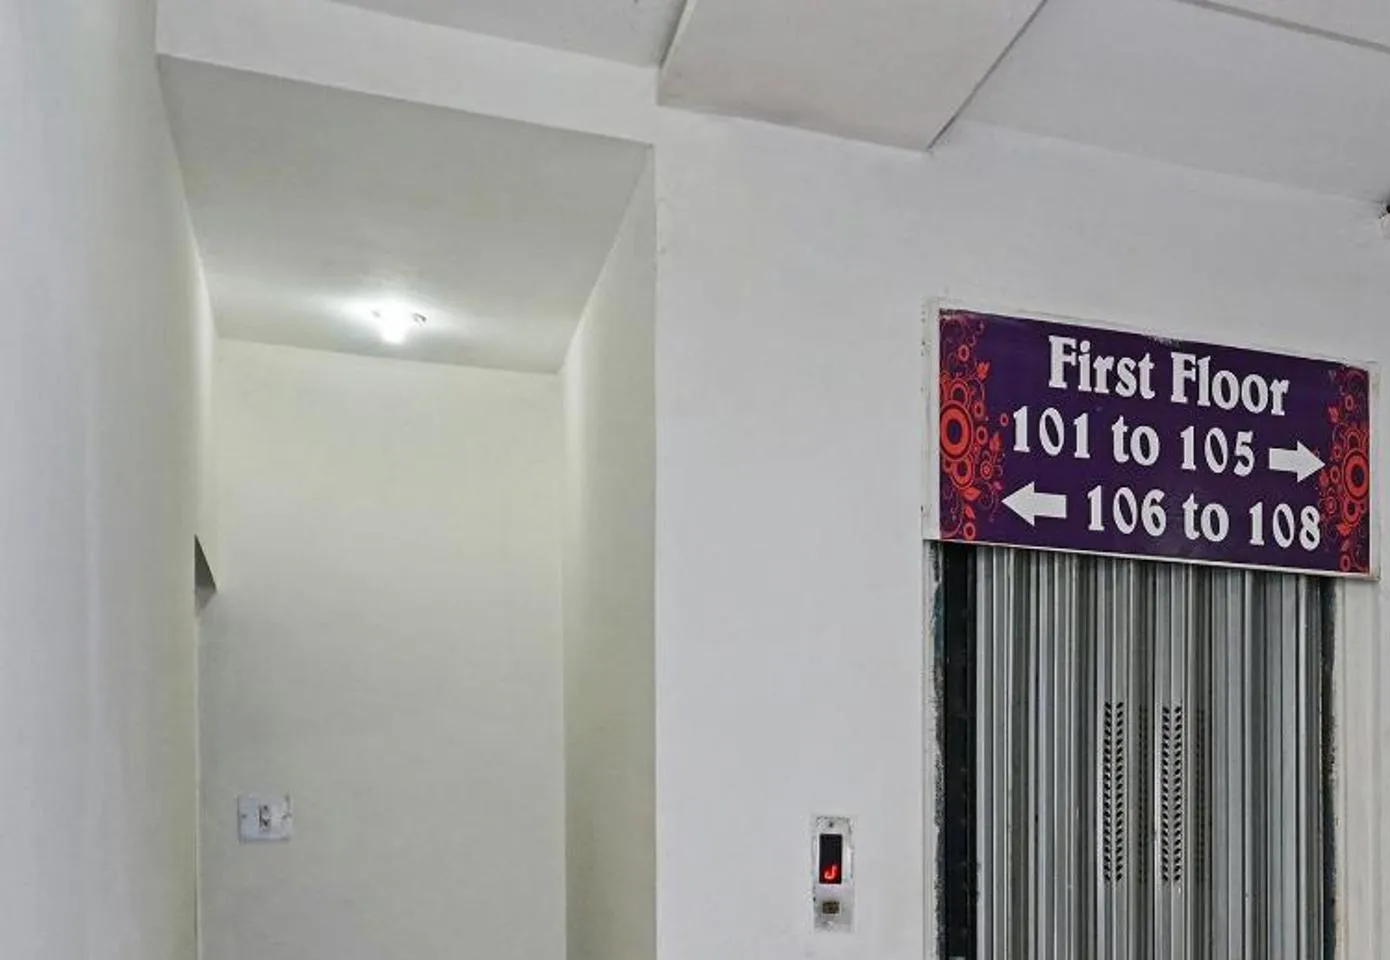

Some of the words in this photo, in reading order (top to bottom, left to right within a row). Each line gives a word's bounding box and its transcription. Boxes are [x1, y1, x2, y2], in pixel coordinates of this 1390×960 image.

[1048, 335, 1156, 400] First
[1170, 351, 1290, 417] Floor
[1012, 405, 1091, 459] 101
[1111, 415, 1160, 466] to
[1180, 425, 1256, 477] 105
[1087, 485, 1167, 537] 106
[1182, 493, 1230, 542] to
[1249, 501, 1322, 551] 108
